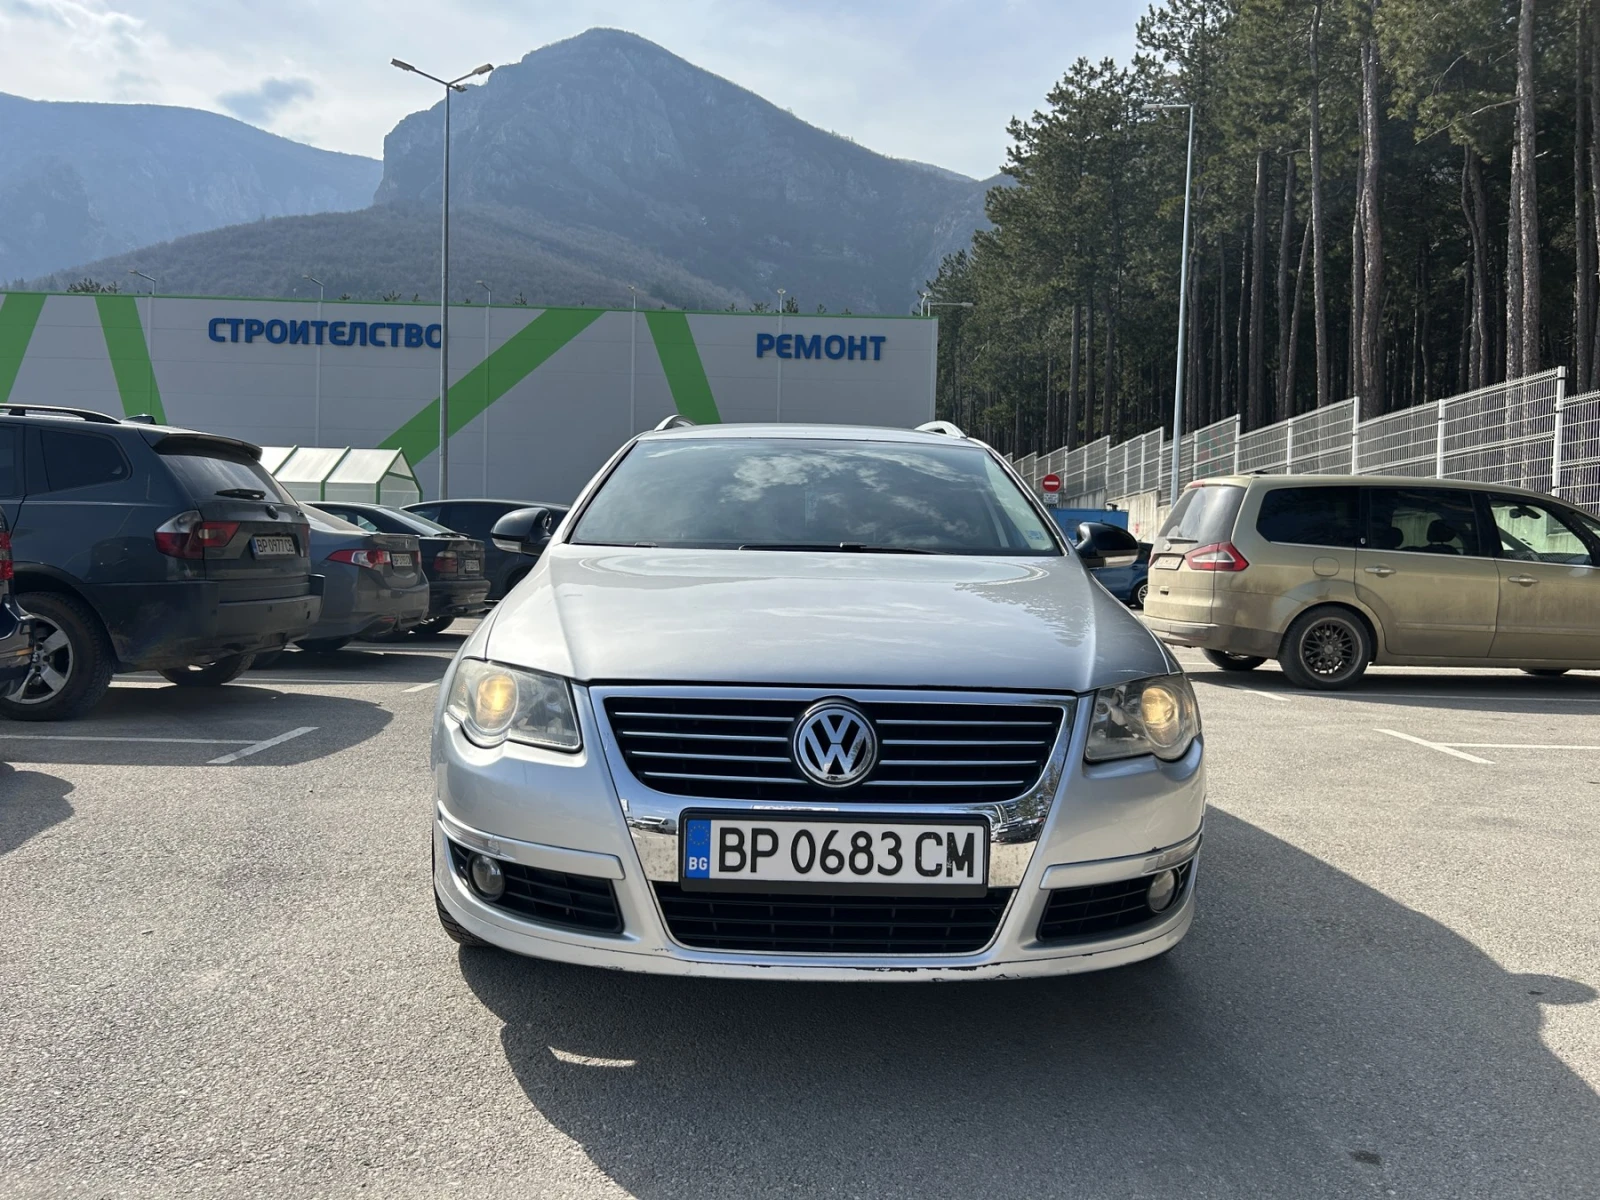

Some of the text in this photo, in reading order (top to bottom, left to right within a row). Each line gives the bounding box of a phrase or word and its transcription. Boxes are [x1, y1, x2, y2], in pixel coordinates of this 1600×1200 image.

[208, 317, 442, 349] СТРОИТЕЛСТВО
[756, 333, 886, 361] РЕМОНТ
[256, 538, 268, 553] BP
[798, 708, 872, 782] VW
[689, 856, 708, 871] BG
[718, 826, 975, 878] BP 0683 CM
